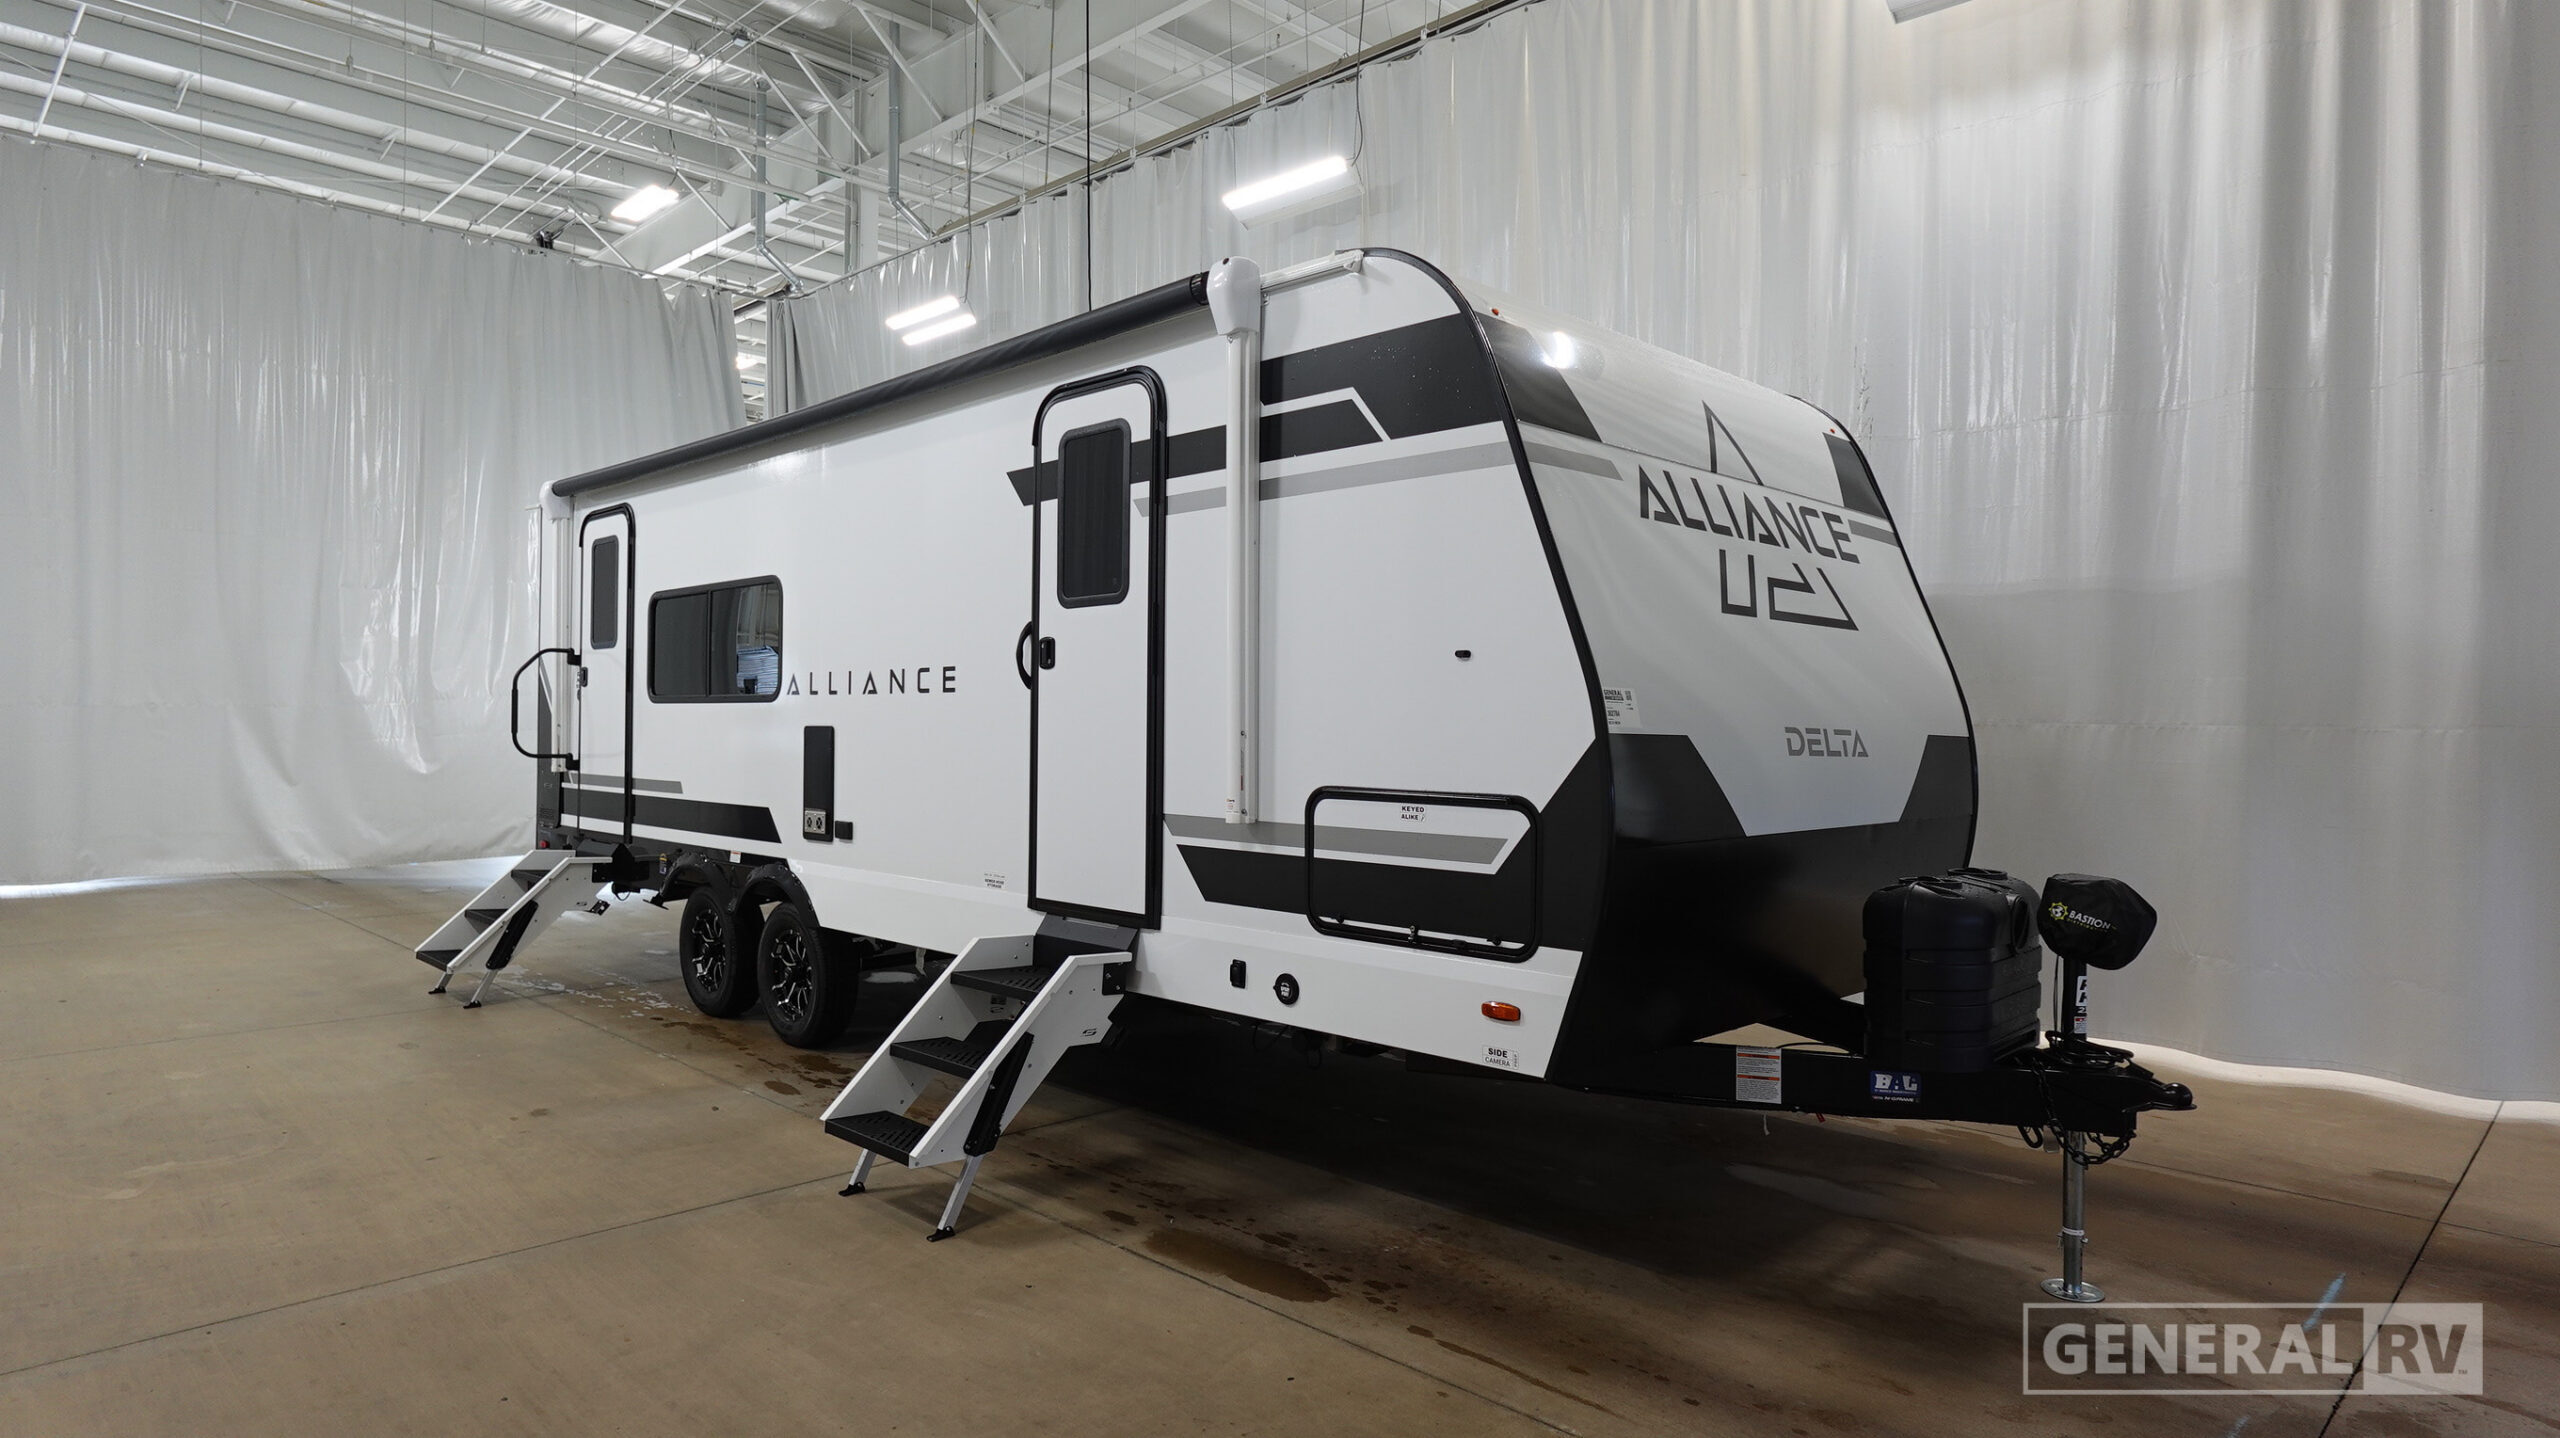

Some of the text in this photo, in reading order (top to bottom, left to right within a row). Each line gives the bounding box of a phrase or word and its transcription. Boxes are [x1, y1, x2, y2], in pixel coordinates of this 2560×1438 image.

[1638, 463, 1861, 564] ALLIANCE
[786, 666, 956, 696] ALLIANCE
[1784, 726, 1869, 758] DELTA
[1401, 805, 1425, 813] KEYED
[2068, 910, 2111, 930] BASTION
[1484, 1056, 1511, 1067] CAMERA
[1488, 1047, 1508, 1059] SIDE
